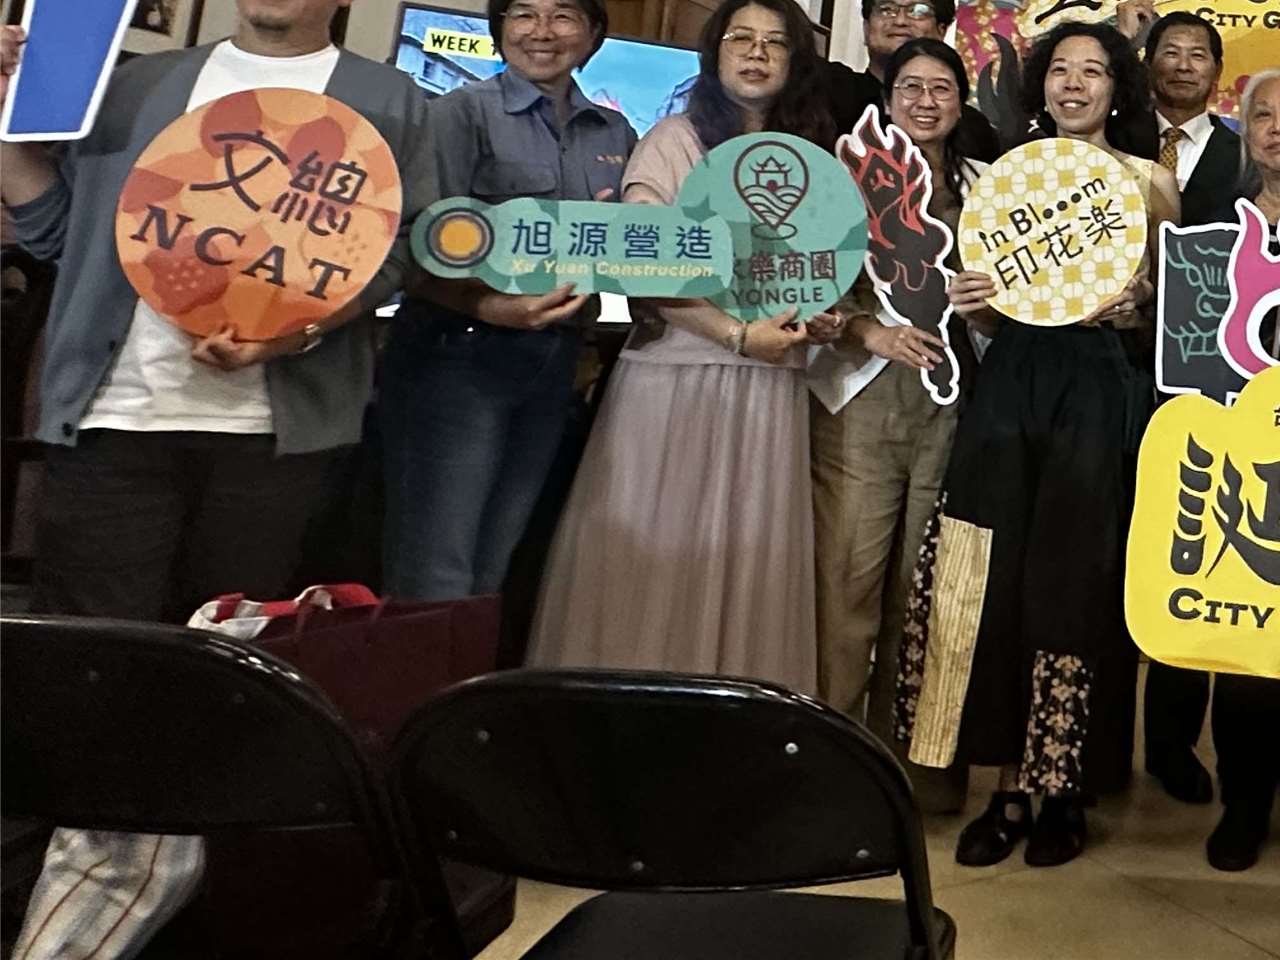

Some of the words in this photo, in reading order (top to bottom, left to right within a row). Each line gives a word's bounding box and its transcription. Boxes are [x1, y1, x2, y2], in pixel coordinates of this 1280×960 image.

[1197, 9, 1257, 28] CITY
[431, 33, 481, 55] WEEK
[511, 218, 713, 260] 旭源營造
[979, 228, 1010, 253] in
[130, 204, 352, 301] NCAT
[511, 259, 536, 273] Xu
[544, 260, 589, 275] Yuan
[597, 261, 714, 277] Construction
[731, 287, 824, 305] YONGLE
[1168, 587, 1274, 629] CITY
